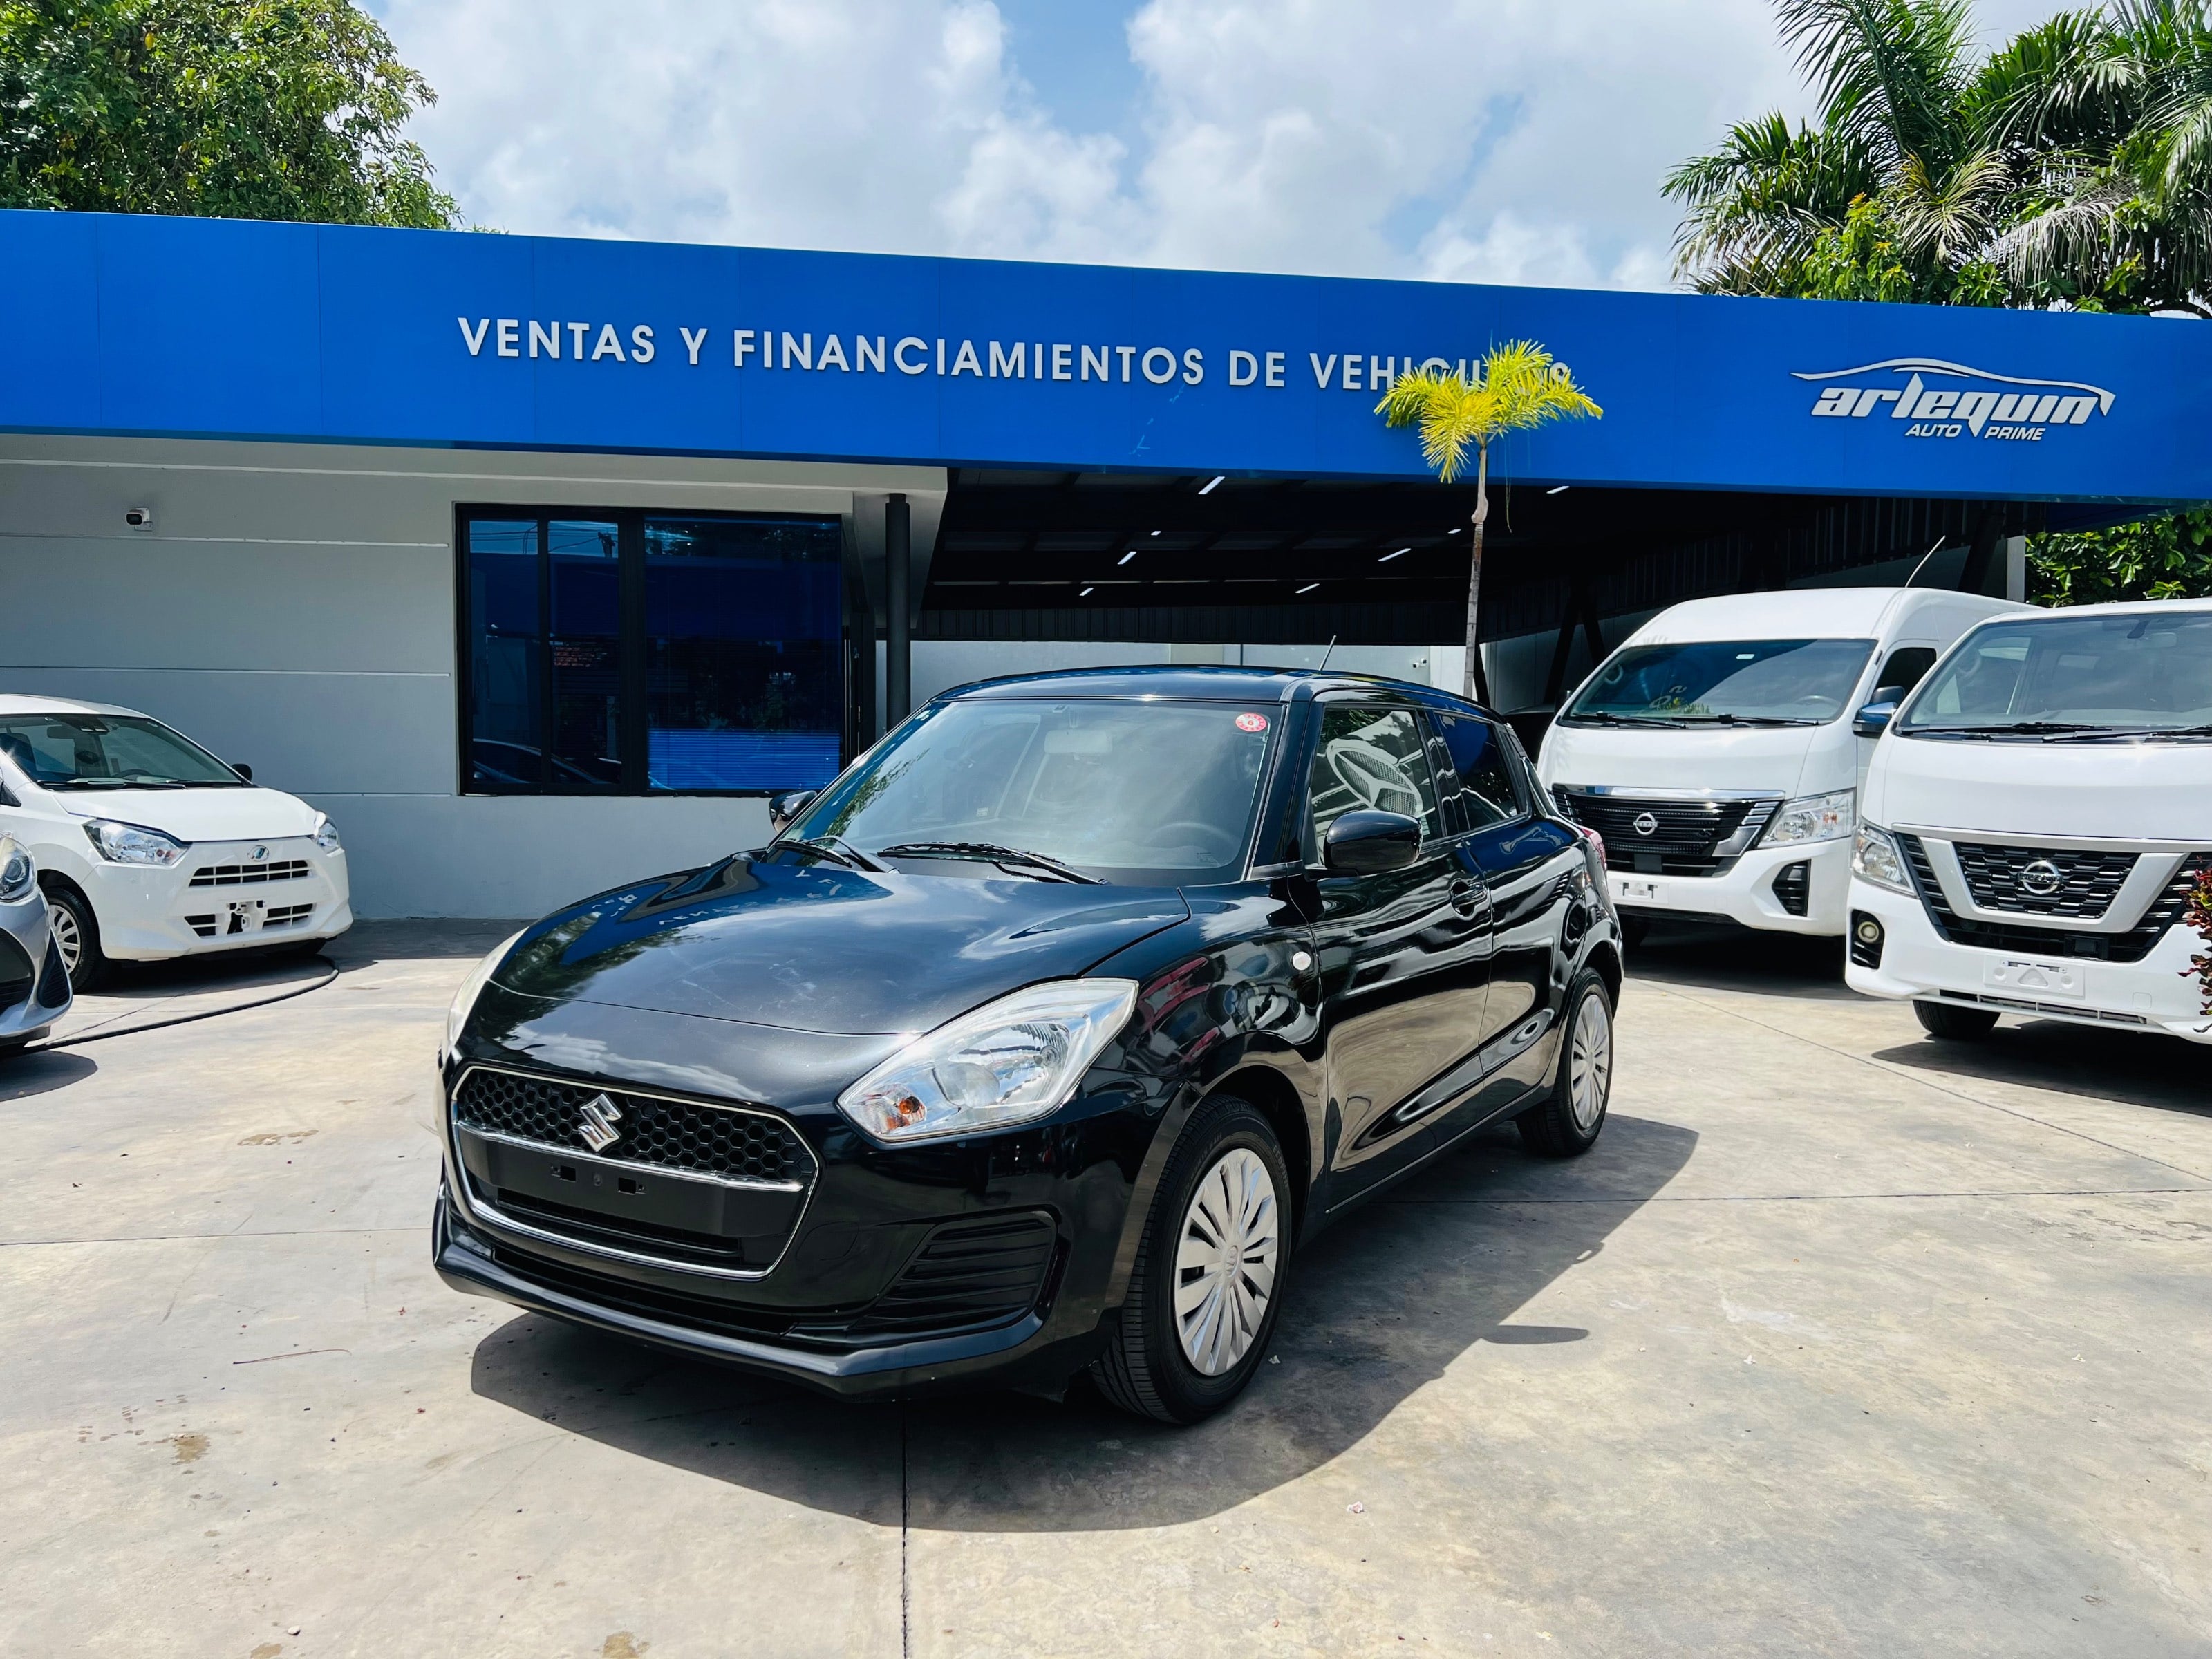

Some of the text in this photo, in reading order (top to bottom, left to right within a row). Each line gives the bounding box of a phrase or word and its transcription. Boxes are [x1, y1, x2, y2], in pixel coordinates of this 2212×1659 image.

[458, 317, 655, 363] VENTAS
[679, 327, 707, 365] Y
[734, 330, 1203, 385] FINANCIAMIENTOS
[1230, 350, 1285, 387] DE
[1905, 424, 2046, 440] AUTO PRIME
